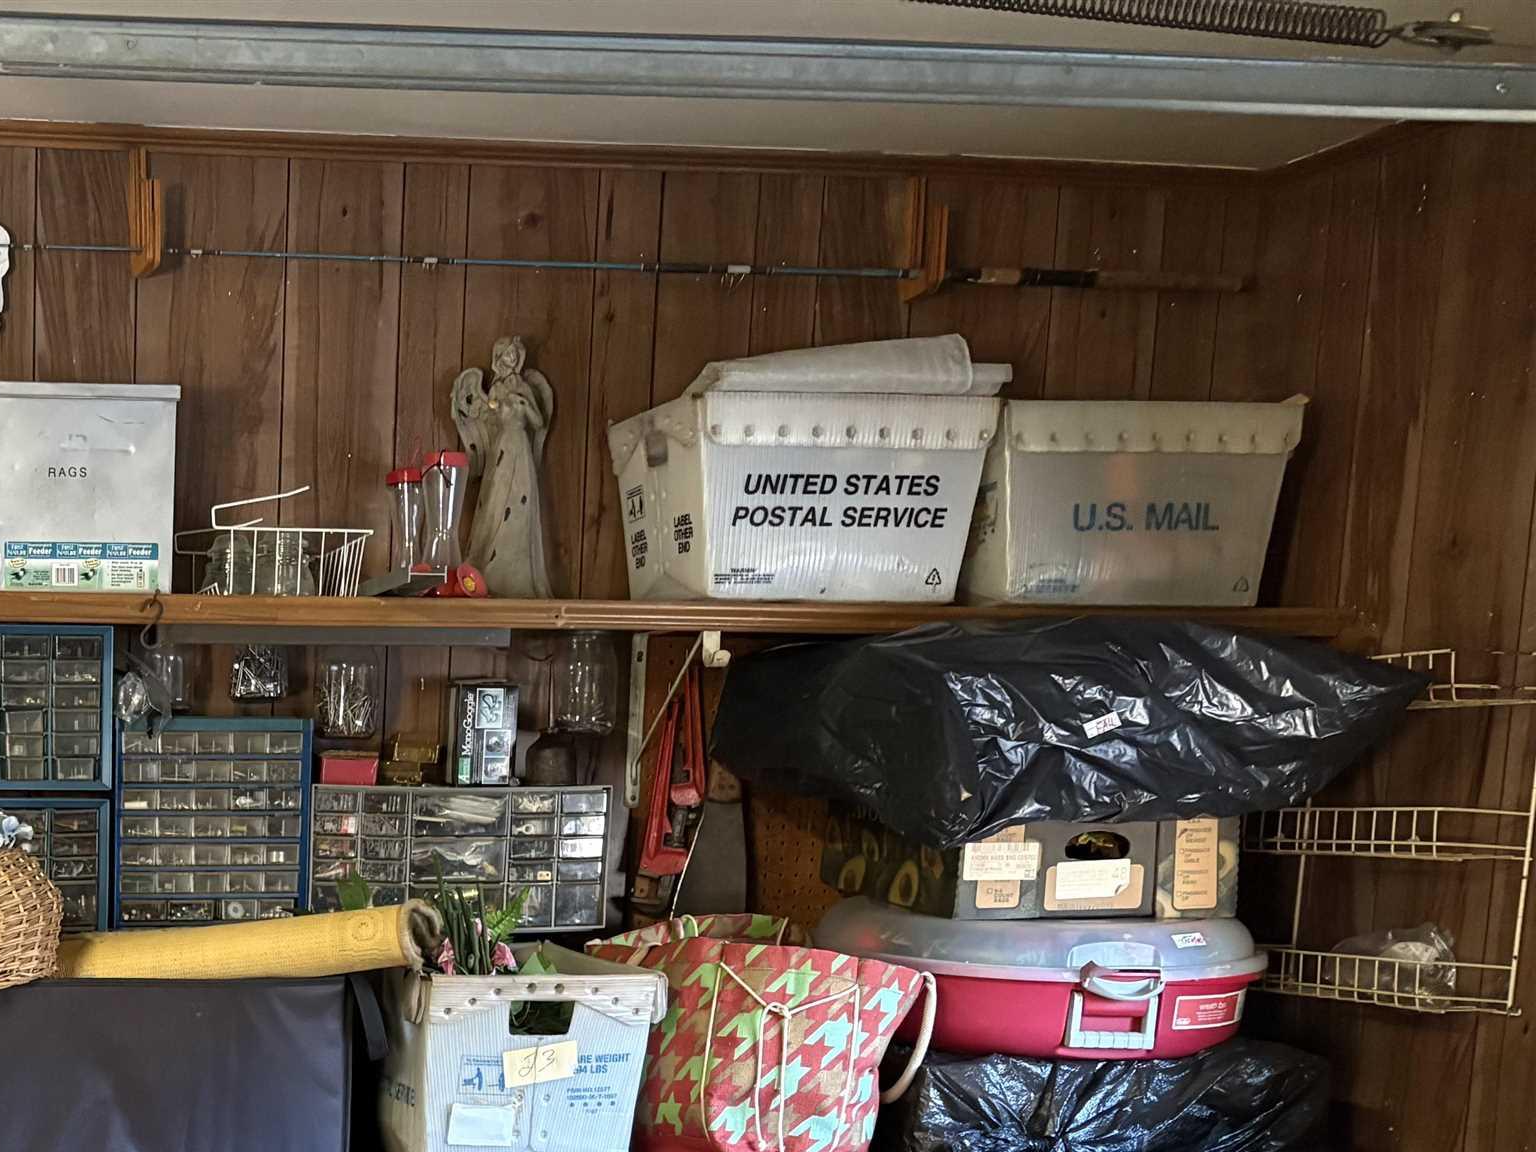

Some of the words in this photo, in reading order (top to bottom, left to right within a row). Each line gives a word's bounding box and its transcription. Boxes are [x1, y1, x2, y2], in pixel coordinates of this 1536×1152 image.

[47, 466, 88, 480] RAGS
[744, 474, 837, 495] UNITED
[844, 475, 940, 496] STATES
[673, 514, 692, 528] LABEL
[732, 507, 833, 528] POSTAL
[841, 507, 948, 528] SERVICE
[1072, 502, 1134, 532] U.S.
[1144, 502, 1220, 531] MAIL
[631, 530, 647, 545] LABEL
[673, 526, 693, 542] OTHER
[28, 548, 53, 556] Feeder
[78, 548, 103, 556] Feeder
[128, 549, 152, 557] Feeder
[632, 542, 648, 558] OTHER
[677, 541, 691, 555] END
[635, 556, 646, 569] END
[461, 690, 476, 756] MonoGoggle
[595, 1052, 631, 1064] WEIGHT
[591, 1064, 608, 1074] LBS
